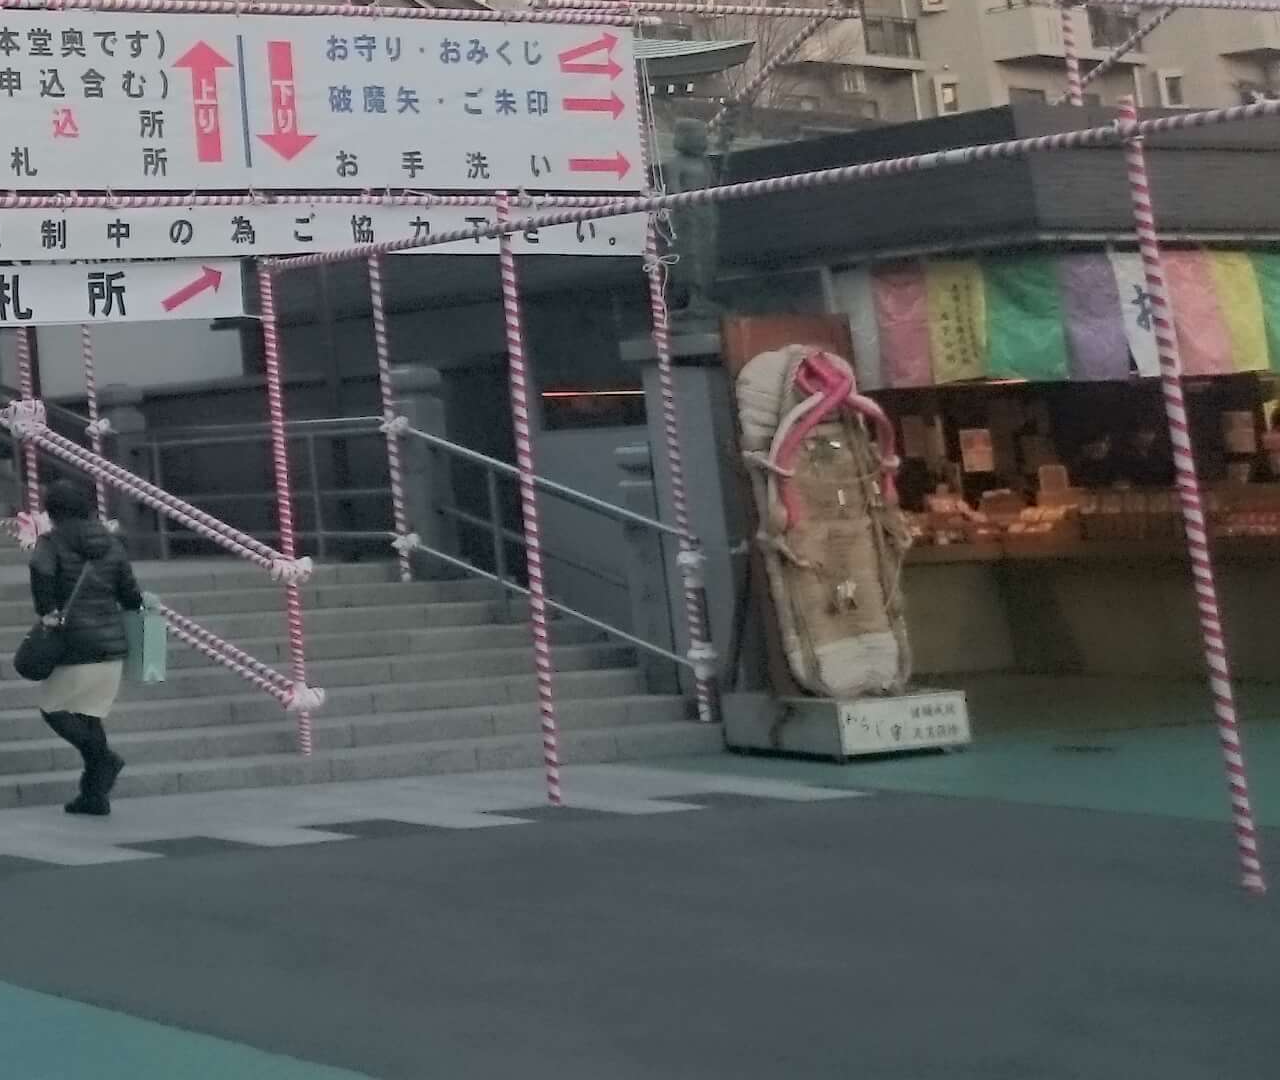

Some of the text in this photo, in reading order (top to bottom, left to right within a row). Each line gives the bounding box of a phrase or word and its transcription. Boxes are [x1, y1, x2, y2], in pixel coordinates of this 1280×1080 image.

[327, 34, 543, 68] お守り・おみくじ
[329, 85, 550, 117] 破魔矢・ご朱印
[336, 149, 552, 179] お手洗い
